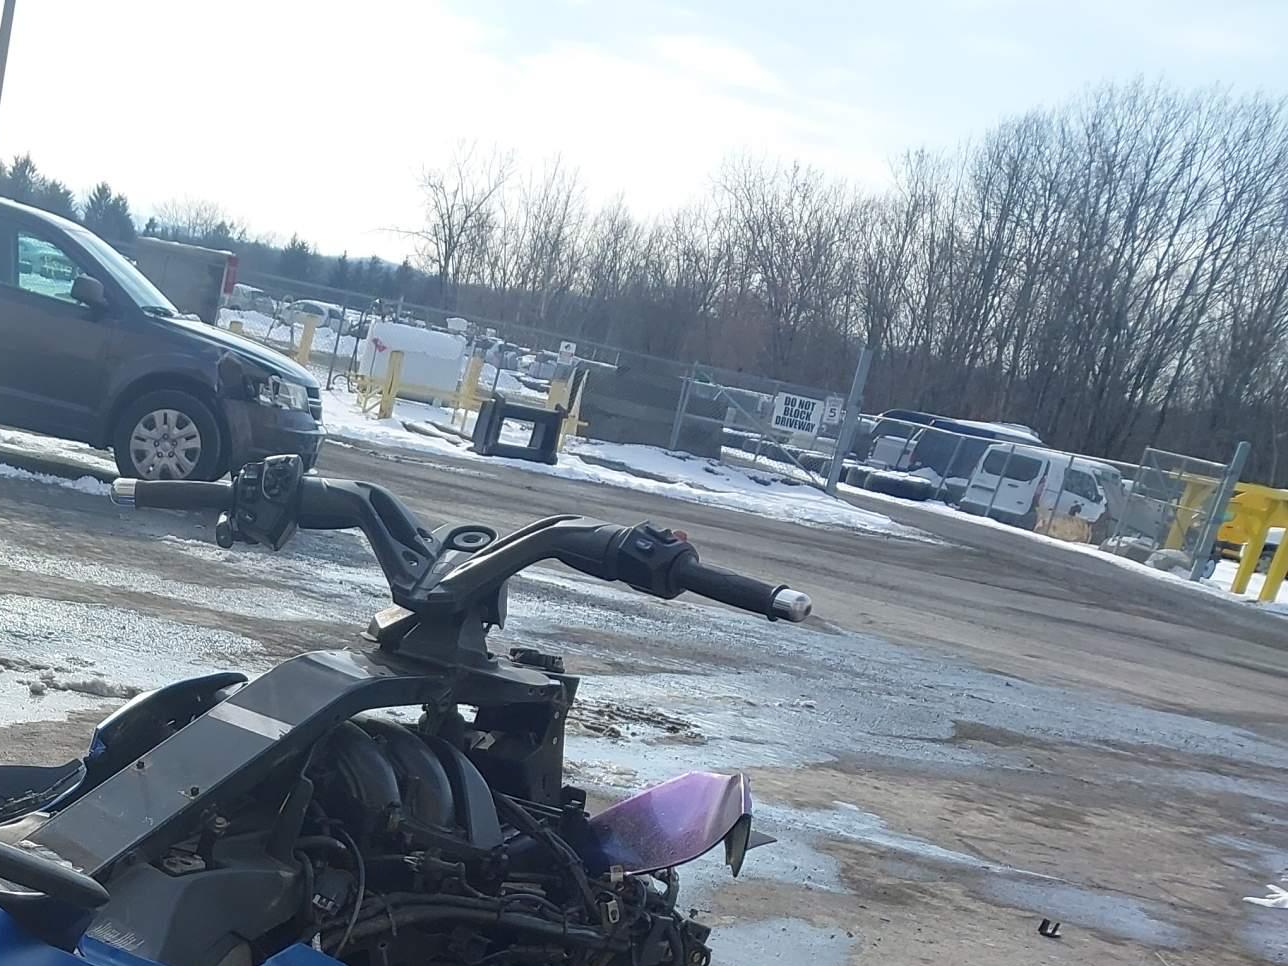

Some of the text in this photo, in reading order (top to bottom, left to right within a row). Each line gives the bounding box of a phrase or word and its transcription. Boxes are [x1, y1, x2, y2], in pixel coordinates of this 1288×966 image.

[784, 396, 797, 407] DO
[798, 399, 816, 412] NOT
[783, 406, 813, 421] BLOCK
[829, 407, 837, 417] 5
[775, 415, 815, 432] DRIVEWAY
